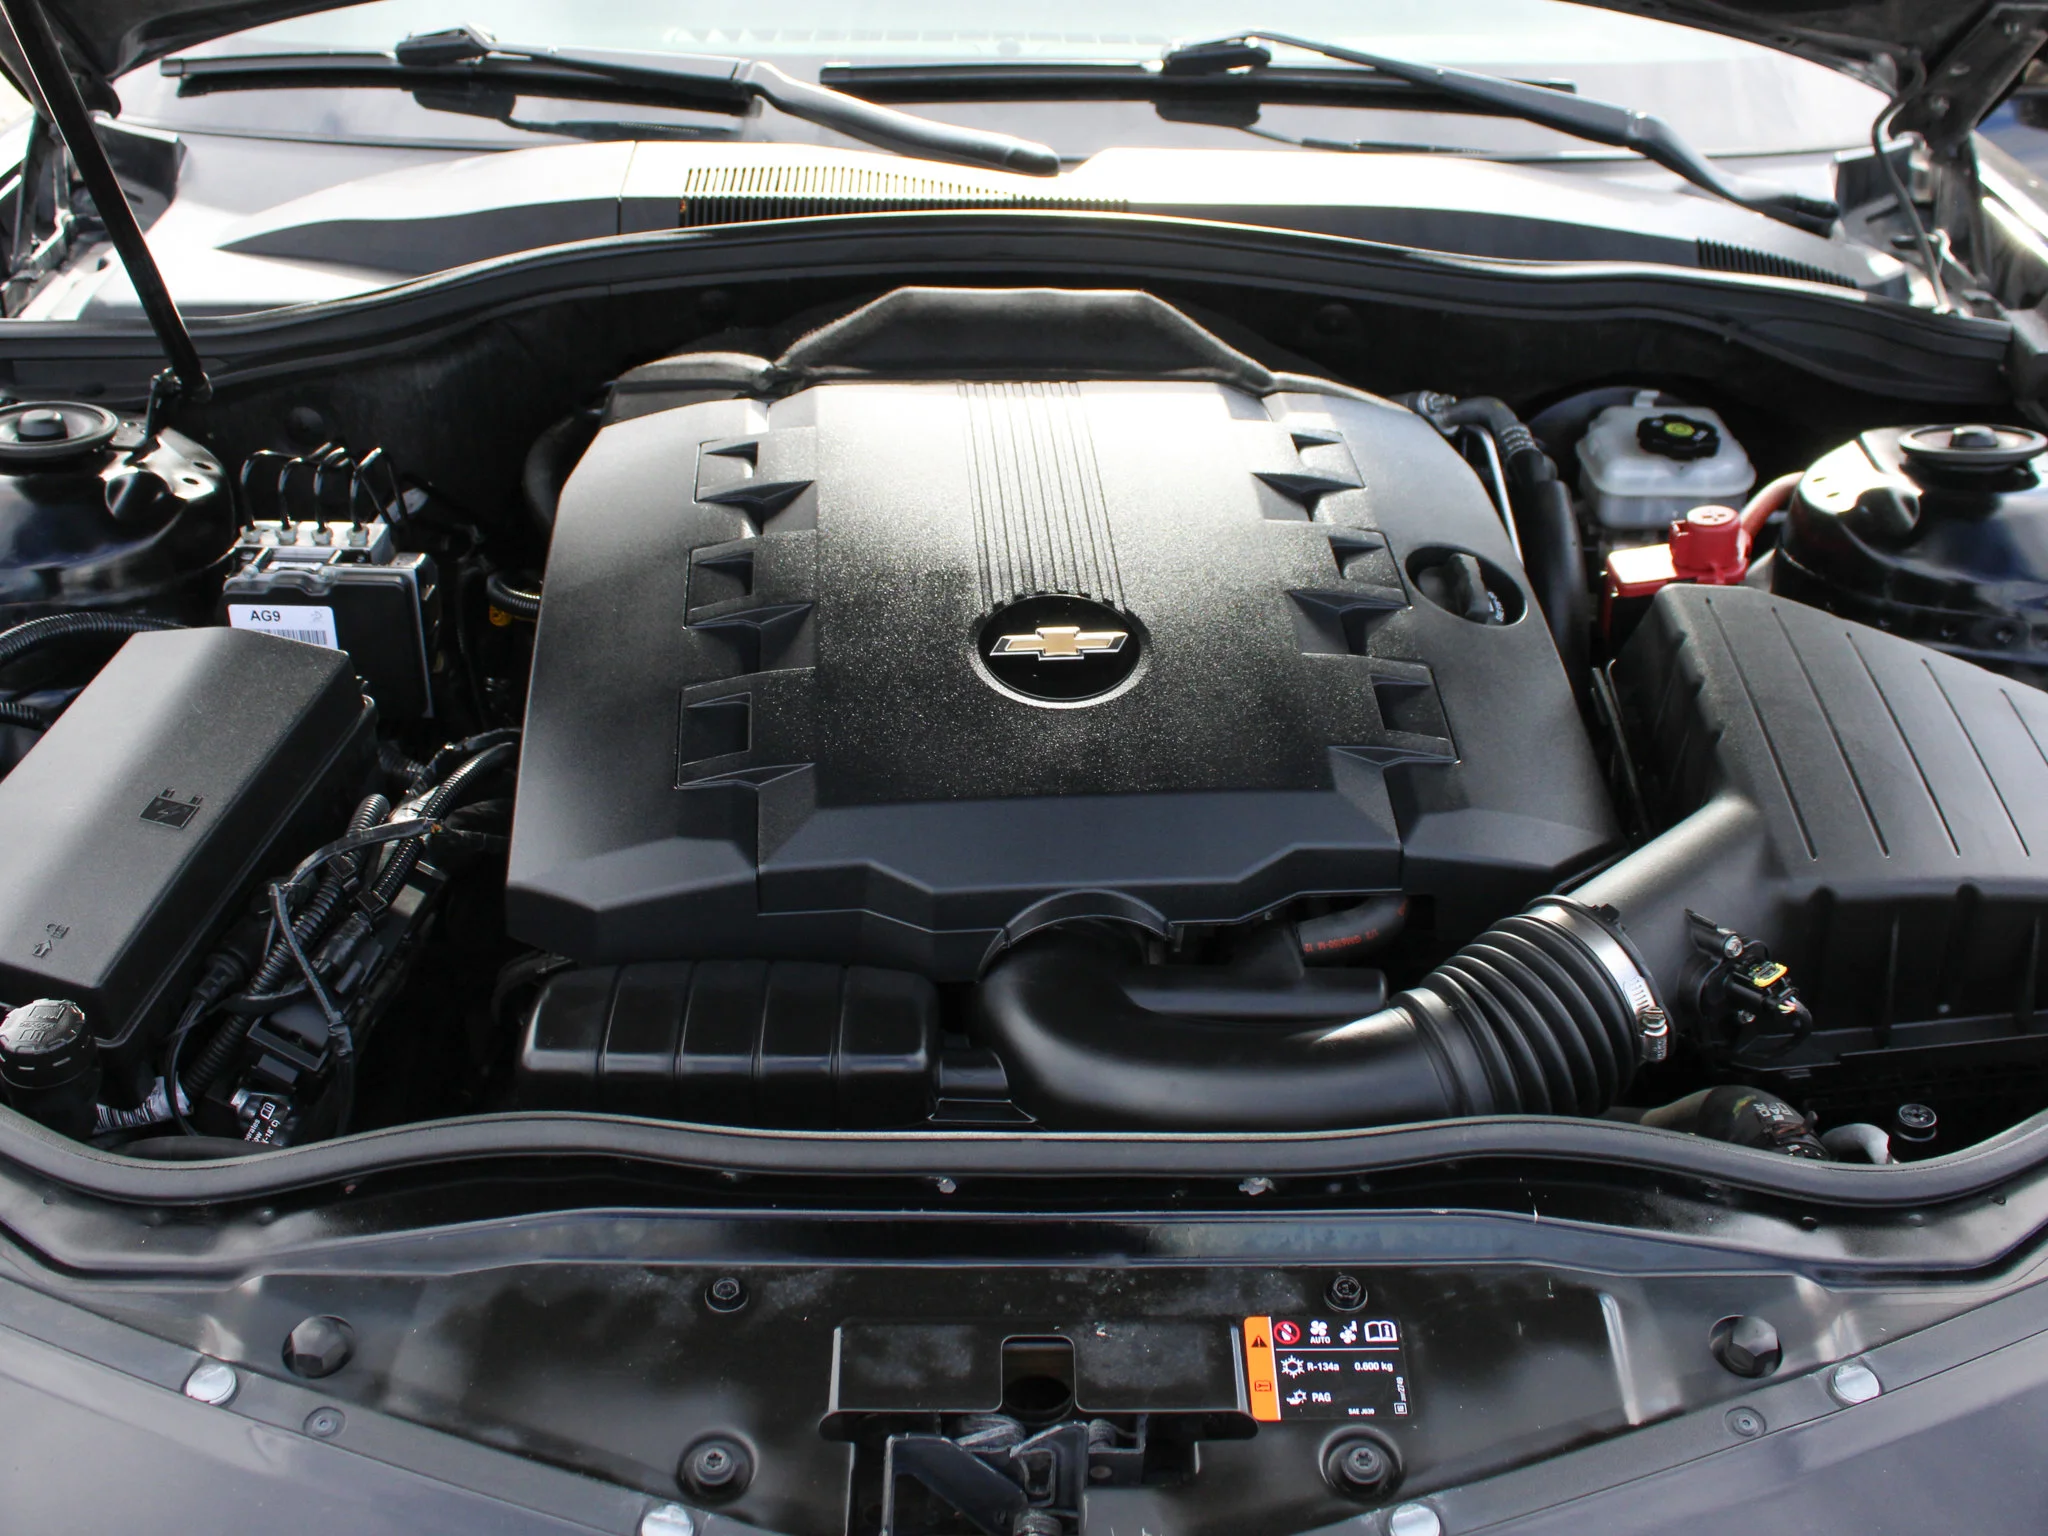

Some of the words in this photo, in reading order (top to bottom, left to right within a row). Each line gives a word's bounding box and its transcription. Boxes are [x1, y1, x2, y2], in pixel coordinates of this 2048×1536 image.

[250, 610, 281, 622] AG9
[1310, 1336, 1331, 1344] AUTO
[1306, 1361, 1340, 1372] R-134a
[1380, 1361, 1394, 1373] kg
[1312, 1392, 1332, 1402] PAG
